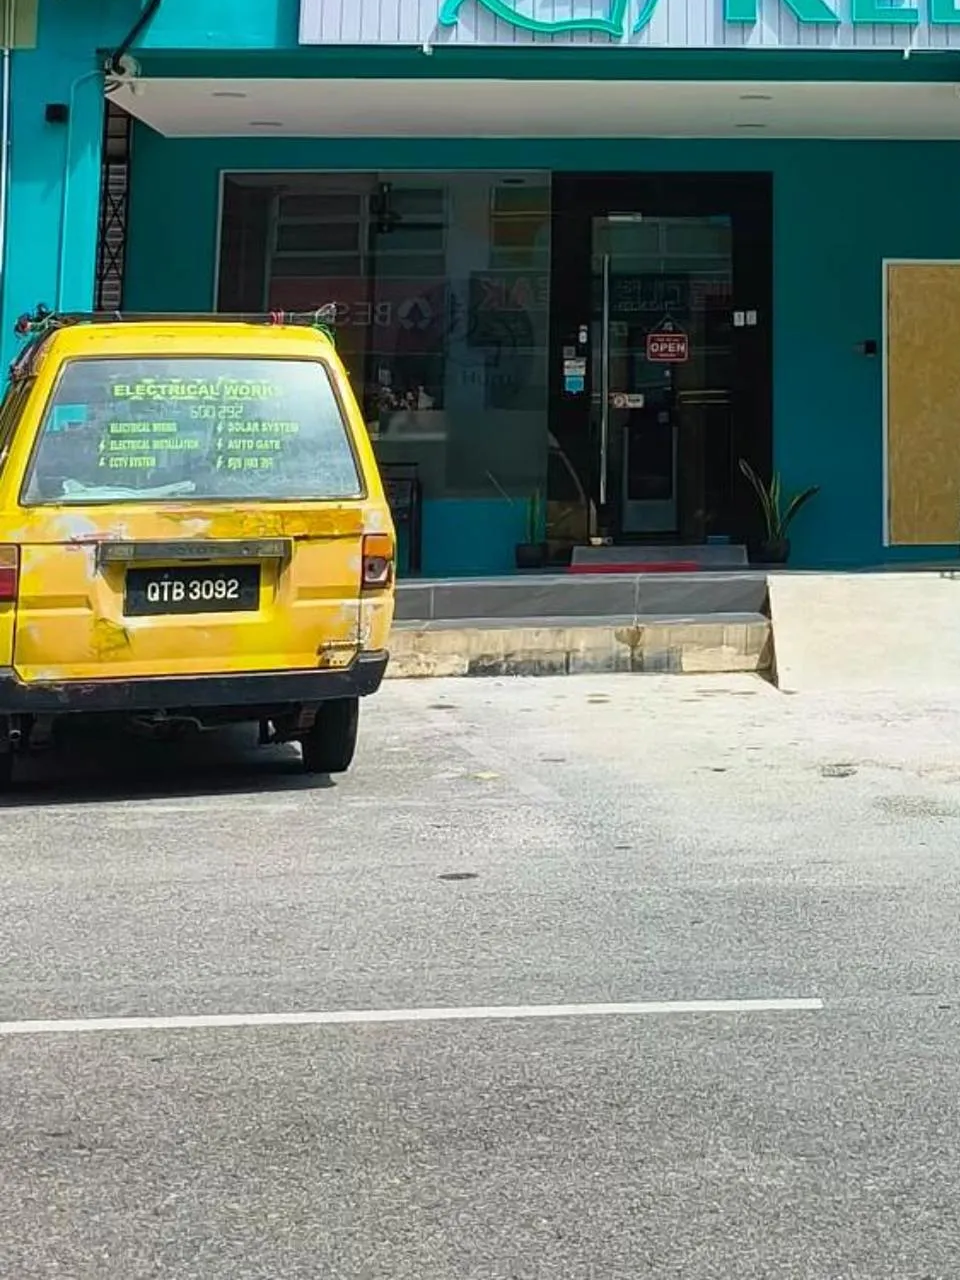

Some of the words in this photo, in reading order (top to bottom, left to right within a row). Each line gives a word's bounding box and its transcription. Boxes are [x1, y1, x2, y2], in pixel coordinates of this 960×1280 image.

[651, 342, 686, 353] OPEN
[113, 383, 220, 397] ELECTRICAL
[228, 439, 254, 450] AUTO
[255, 439, 281, 450] GATE
[147, 581, 186, 602] QTB
[188, 578, 240, 600] 3092
